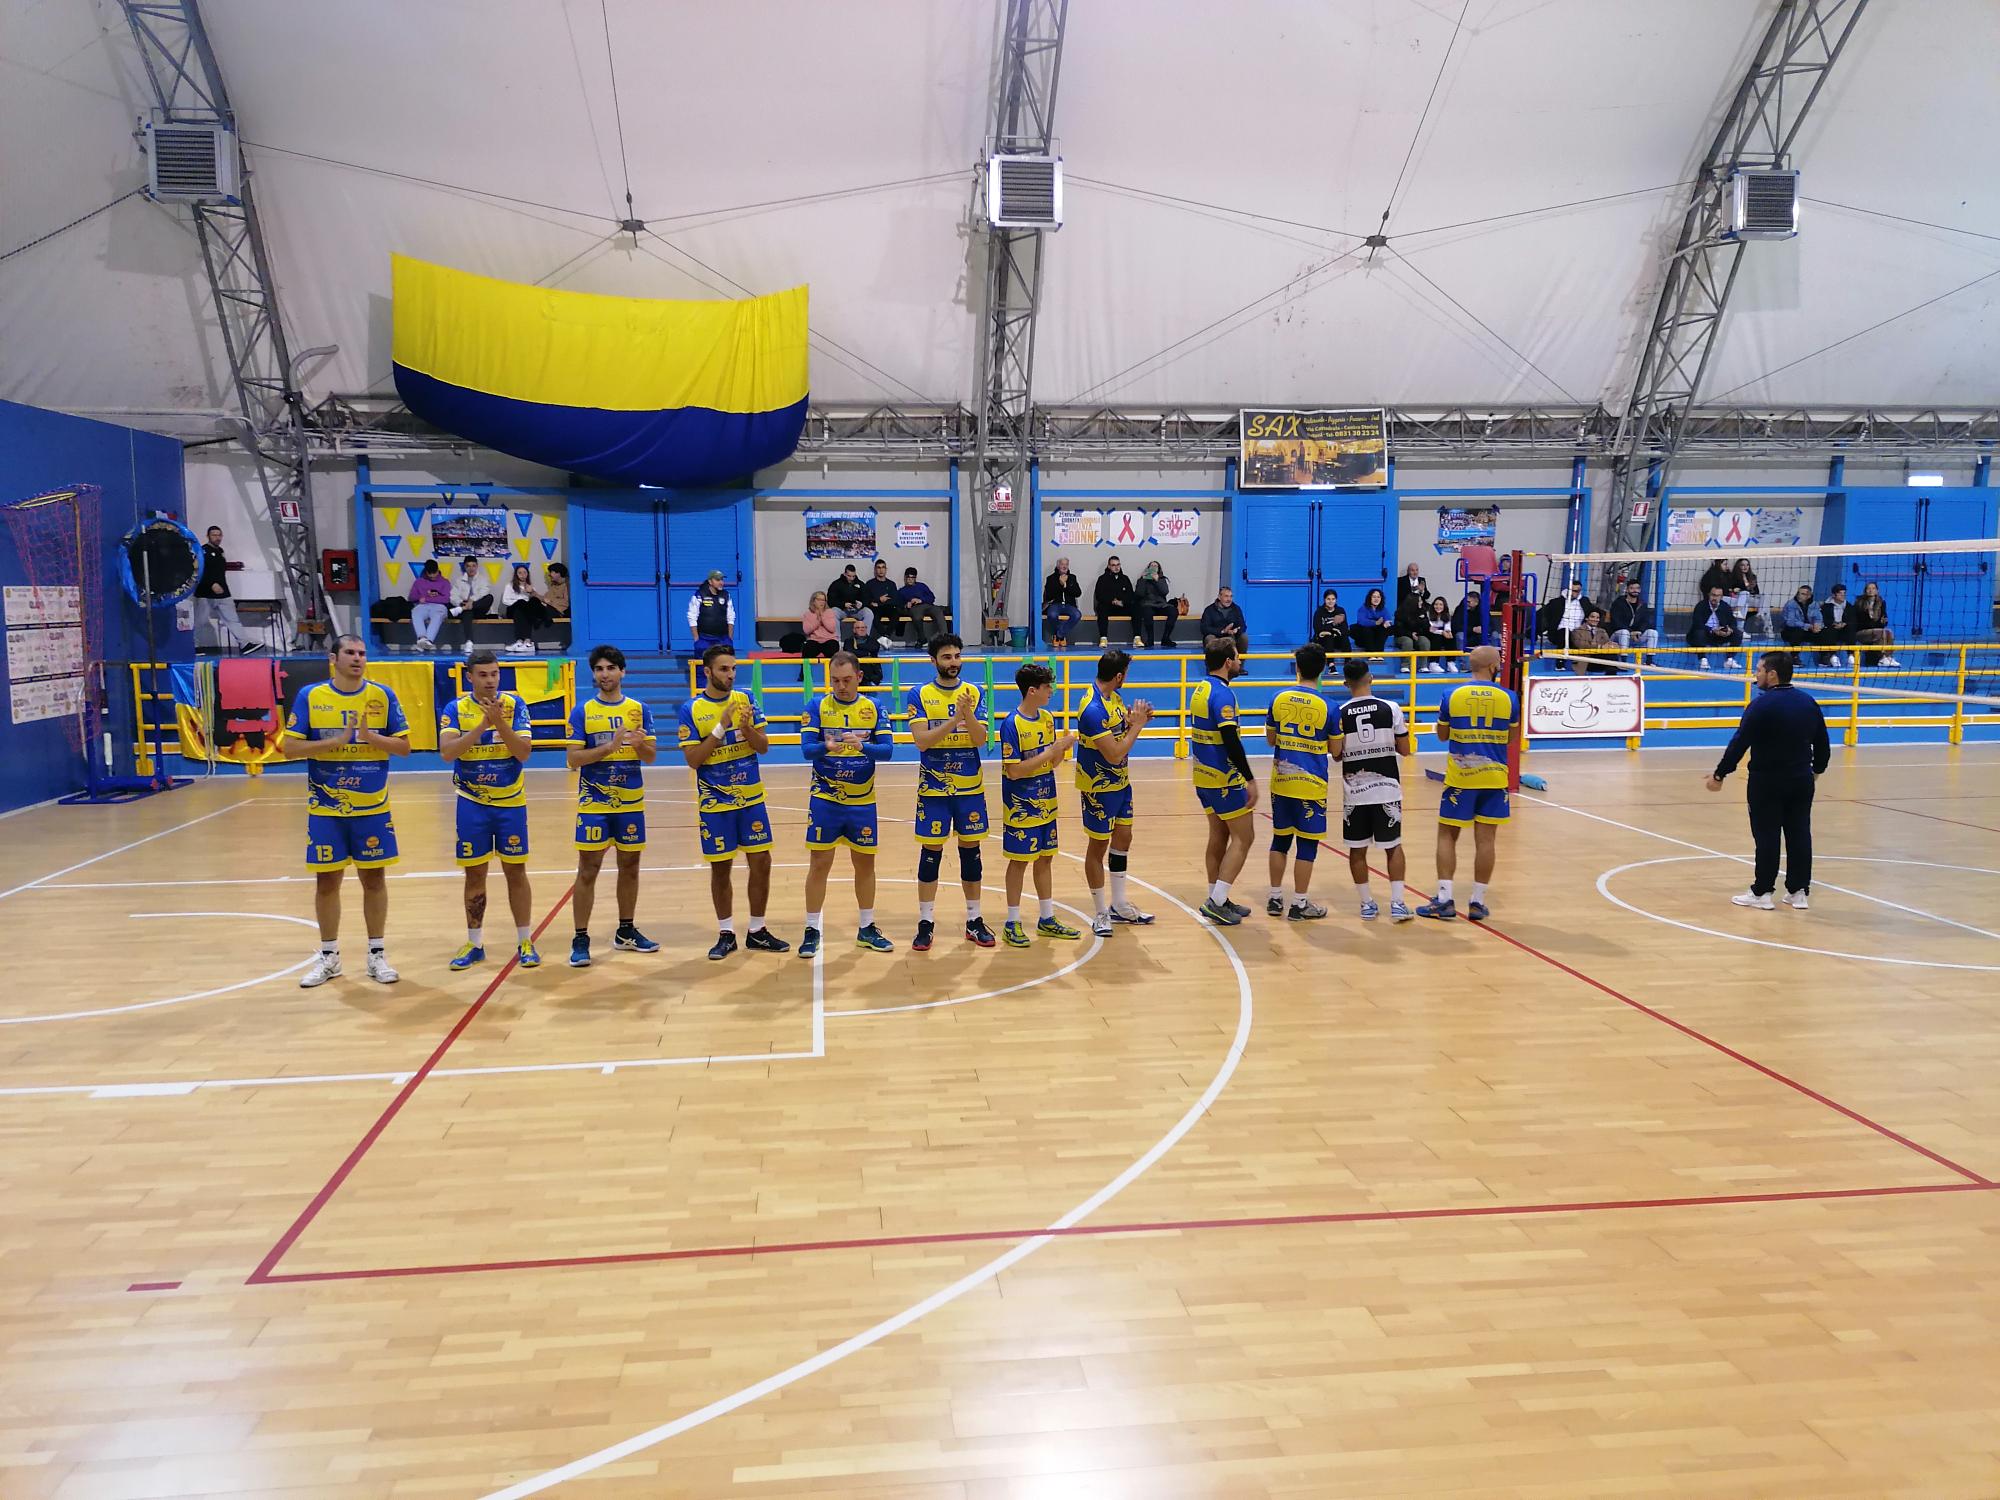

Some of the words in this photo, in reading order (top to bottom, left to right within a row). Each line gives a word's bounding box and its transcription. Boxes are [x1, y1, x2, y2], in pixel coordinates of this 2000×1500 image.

[1247, 414, 1301, 437] SAX
[1158, 519, 1191, 531] STOP
[1068, 530, 1099, 544] DONNE
[947, 703, 956, 717] 8
[1347, 704, 1378, 716] ASCIANO
[1465, 698, 1496, 728] 11
[842, 714, 849, 727] 1
[1280, 702, 1321, 738] 28
[1355, 713, 1376, 743] 6
[1036, 732, 1044, 745] 2
[1368, 747, 1381, 755] 2000
[943, 761, 963, 770] SAX
[476, 773, 497, 782] SAX
[729, 772, 748, 783] SAX
[835, 769, 855, 778] SAX
[336, 776, 362, 787] SAX
[585, 825, 602, 841] 10
[815, 826, 822, 841] 1
[931, 820, 943, 835] 8
[462, 841, 474, 857] 3
[714, 836, 726, 851] 5
[1029, 837, 1038, 852] 2
[315, 845, 334, 862] 13
